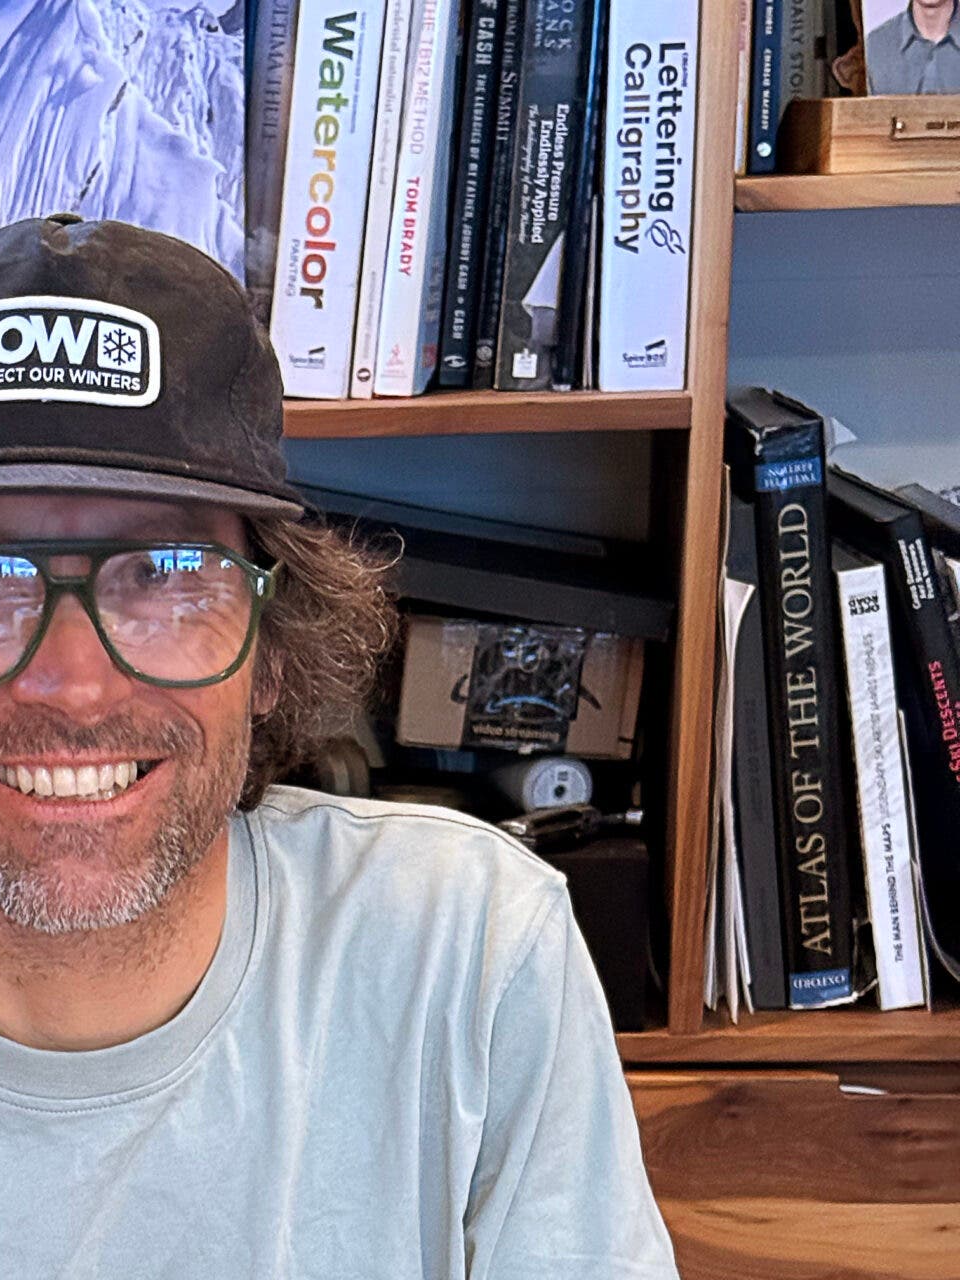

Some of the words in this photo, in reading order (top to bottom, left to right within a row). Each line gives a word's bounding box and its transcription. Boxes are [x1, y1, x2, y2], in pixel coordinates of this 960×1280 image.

[475, 17, 496, 65] CASH
[544, 0, 559, 48] ANS
[559, 0, 575, 49] OCK
[415, 37, 435, 76] TB12
[410, 81, 431, 155] METHOD
[496, 72, 517, 141] SUMMIT
[551, 104, 570, 158] Endless
[648, 43, 686, 212] Lettering
[300, 11, 358, 309] Watercolor
[530, 120, 554, 187] Endlessly
[614, 43, 652, 254] Calligraphy
[403, 177, 421, 213] TOM
[530, 189, 549, 243] Applied
[547, 161, 566, 221] Pressure
[286, 238, 301, 296] PAINTING
[398, 219, 418, 277] BRADY
[29, 366, 65, 383] OUR
[70, 369, 141, 391] WINTERS
[777, 503, 815, 659] WORLD
[785, 667, 820, 759] THE
[928, 660, 958, 741] DESCENTS
[787, 771, 824, 824] OF
[879, 823, 895, 852] MAPS
[882, 854, 895, 873] THE
[793, 832, 833, 954] ATLAS
[885, 876, 900, 914] BEHIND
[889, 916, 902, 940] MAN
[892, 943, 904, 963] THE
[793, 974, 845, 990] OXFORD
